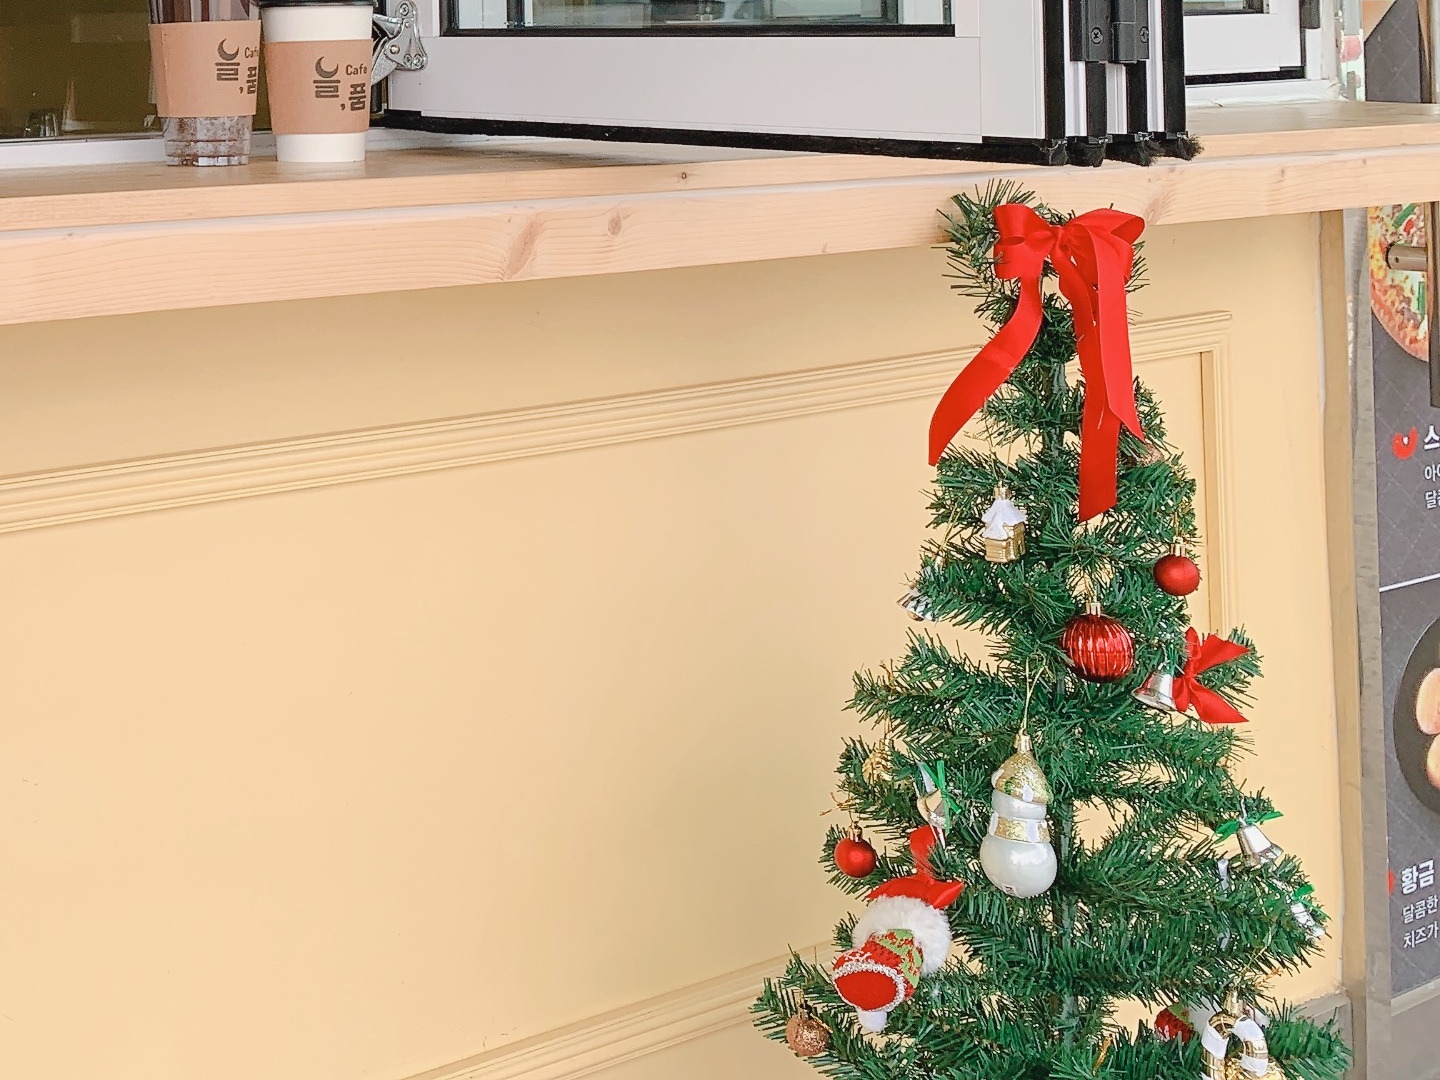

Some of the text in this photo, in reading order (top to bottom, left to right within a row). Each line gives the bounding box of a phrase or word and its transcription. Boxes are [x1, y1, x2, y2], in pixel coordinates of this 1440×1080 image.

[345, 63, 368, 77] Cafe
[1424, 464, 1440, 482] 아
[1425, 489, 1440, 510] 달
[1401, 859, 1435, 896] 황금
[1402, 894, 1439, 925] 달콤한
[1403, 920, 1439, 949] 치즈가
